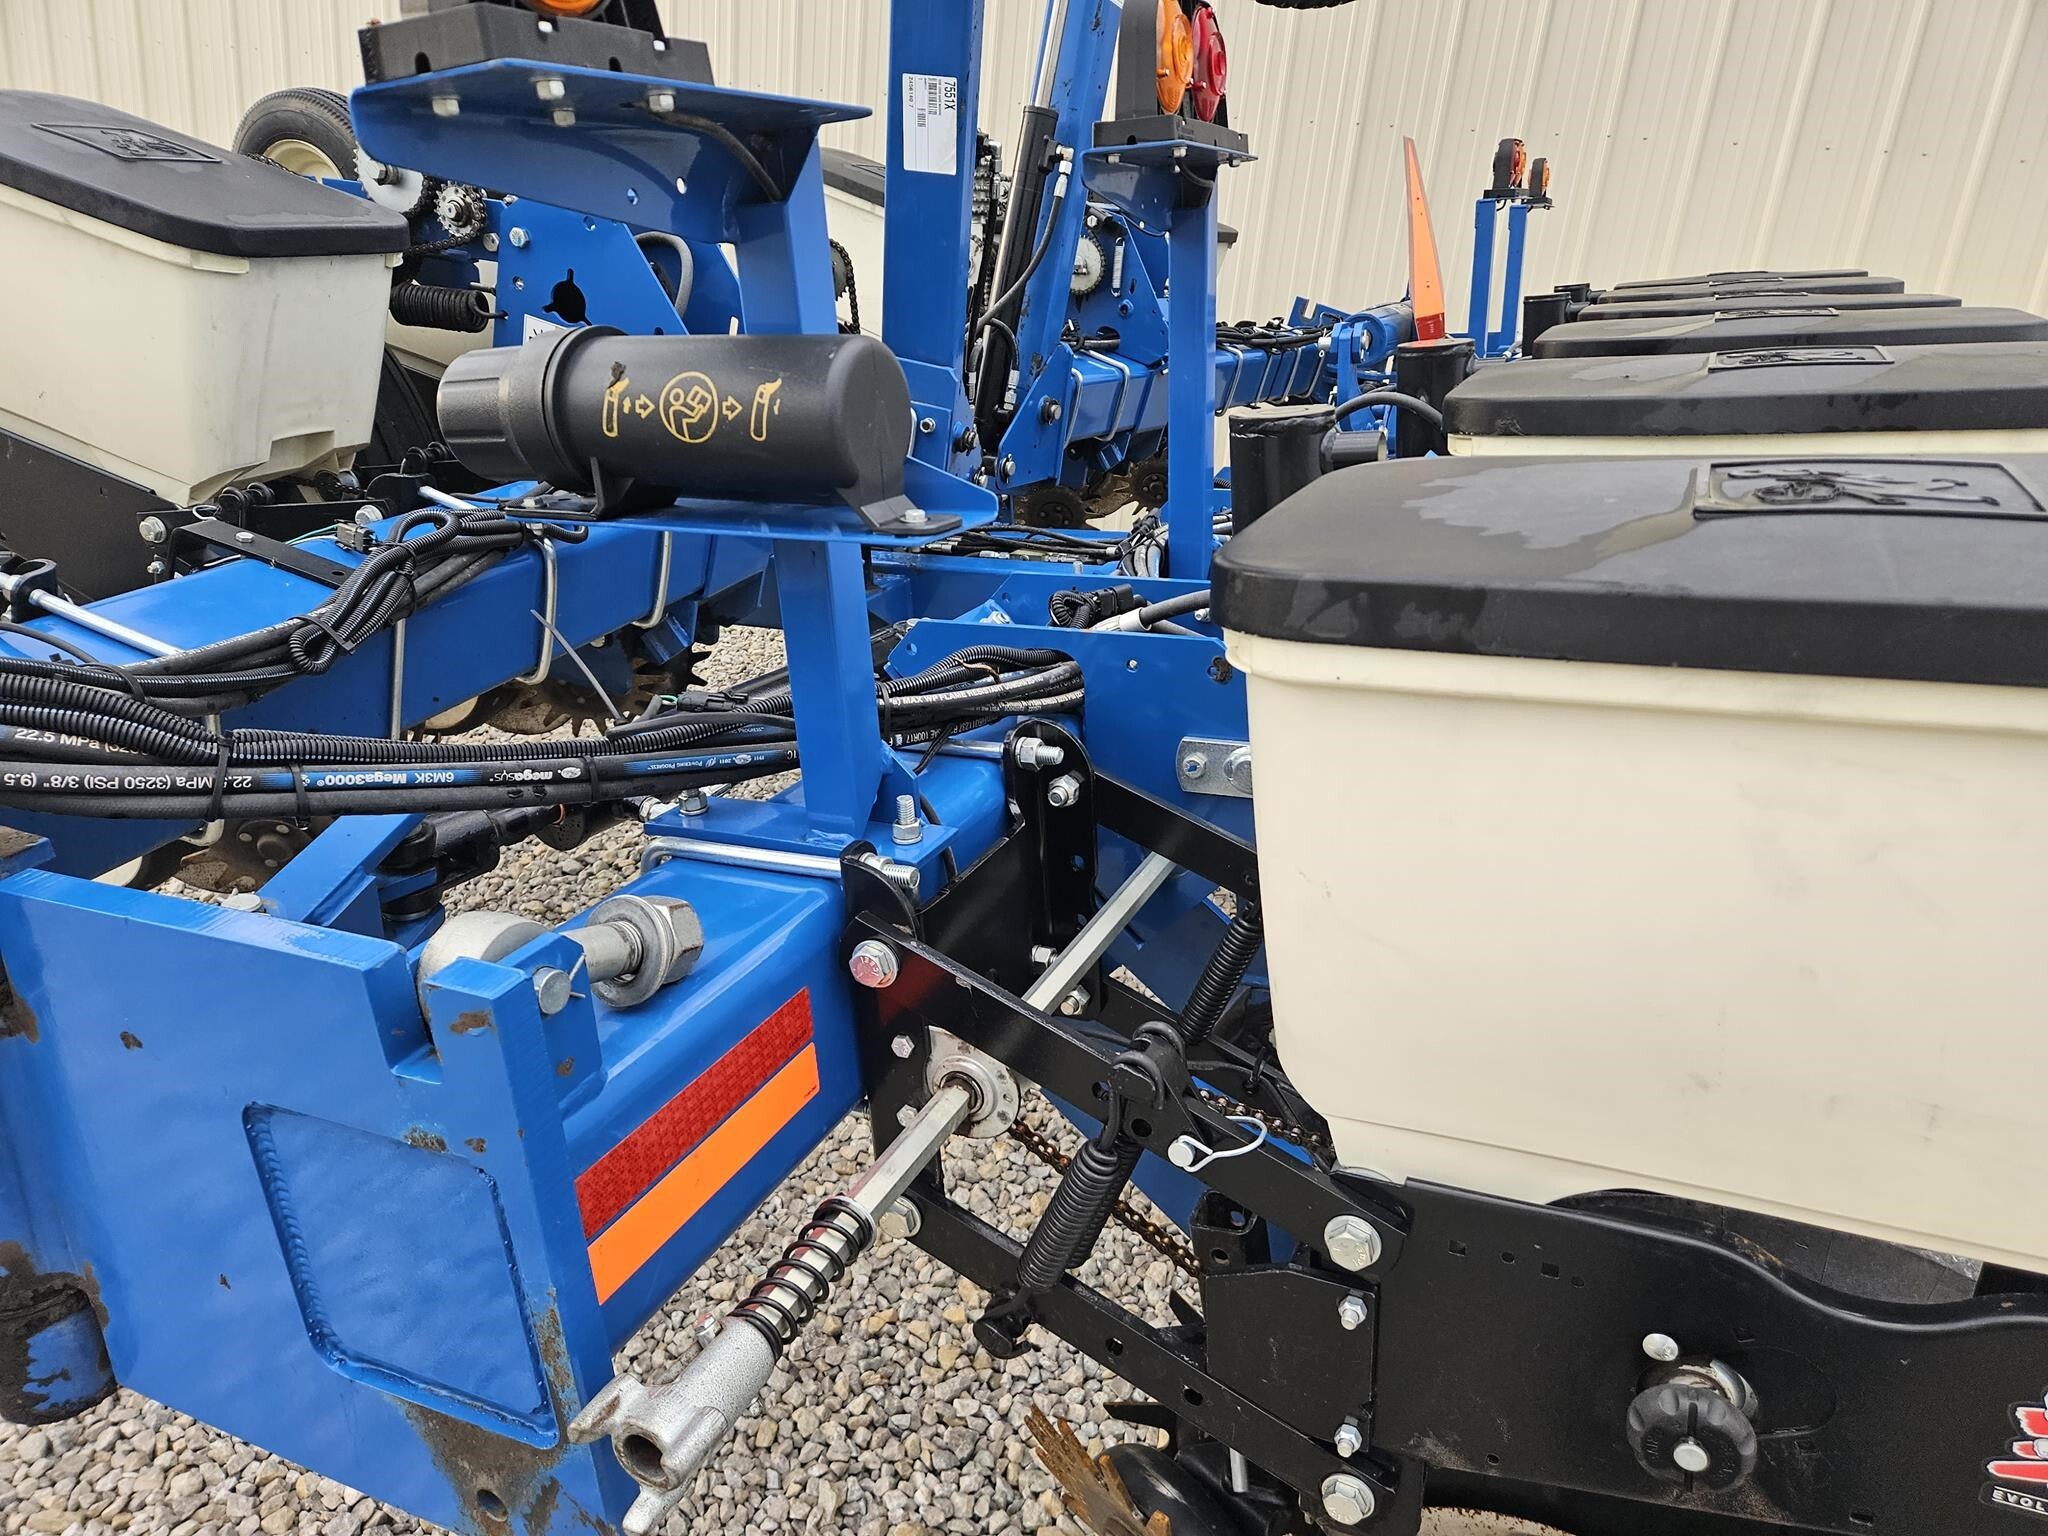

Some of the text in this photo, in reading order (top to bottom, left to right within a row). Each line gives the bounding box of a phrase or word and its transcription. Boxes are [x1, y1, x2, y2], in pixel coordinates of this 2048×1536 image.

[944, 82, 956, 110] 7551X
[903, 695, 924, 705] MAX
[940, 691, 967, 701] FLAME
[967, 683, 1004, 698] RESISTANT
[14, 728, 55, 742] 22.5
[59, 733, 100, 750] MPa
[906, 731, 929, 744] 100R17
[3, 772, 37, 788] (9.5
[43, 774, 80, 789] 3/8"
[84, 774, 120, 790] PSI)
[124, 774, 171, 790] (3250
[176, 775, 213, 789] MPa
[414, 772, 455, 784] 6M3K
[493, 768, 553, 782] megasys
